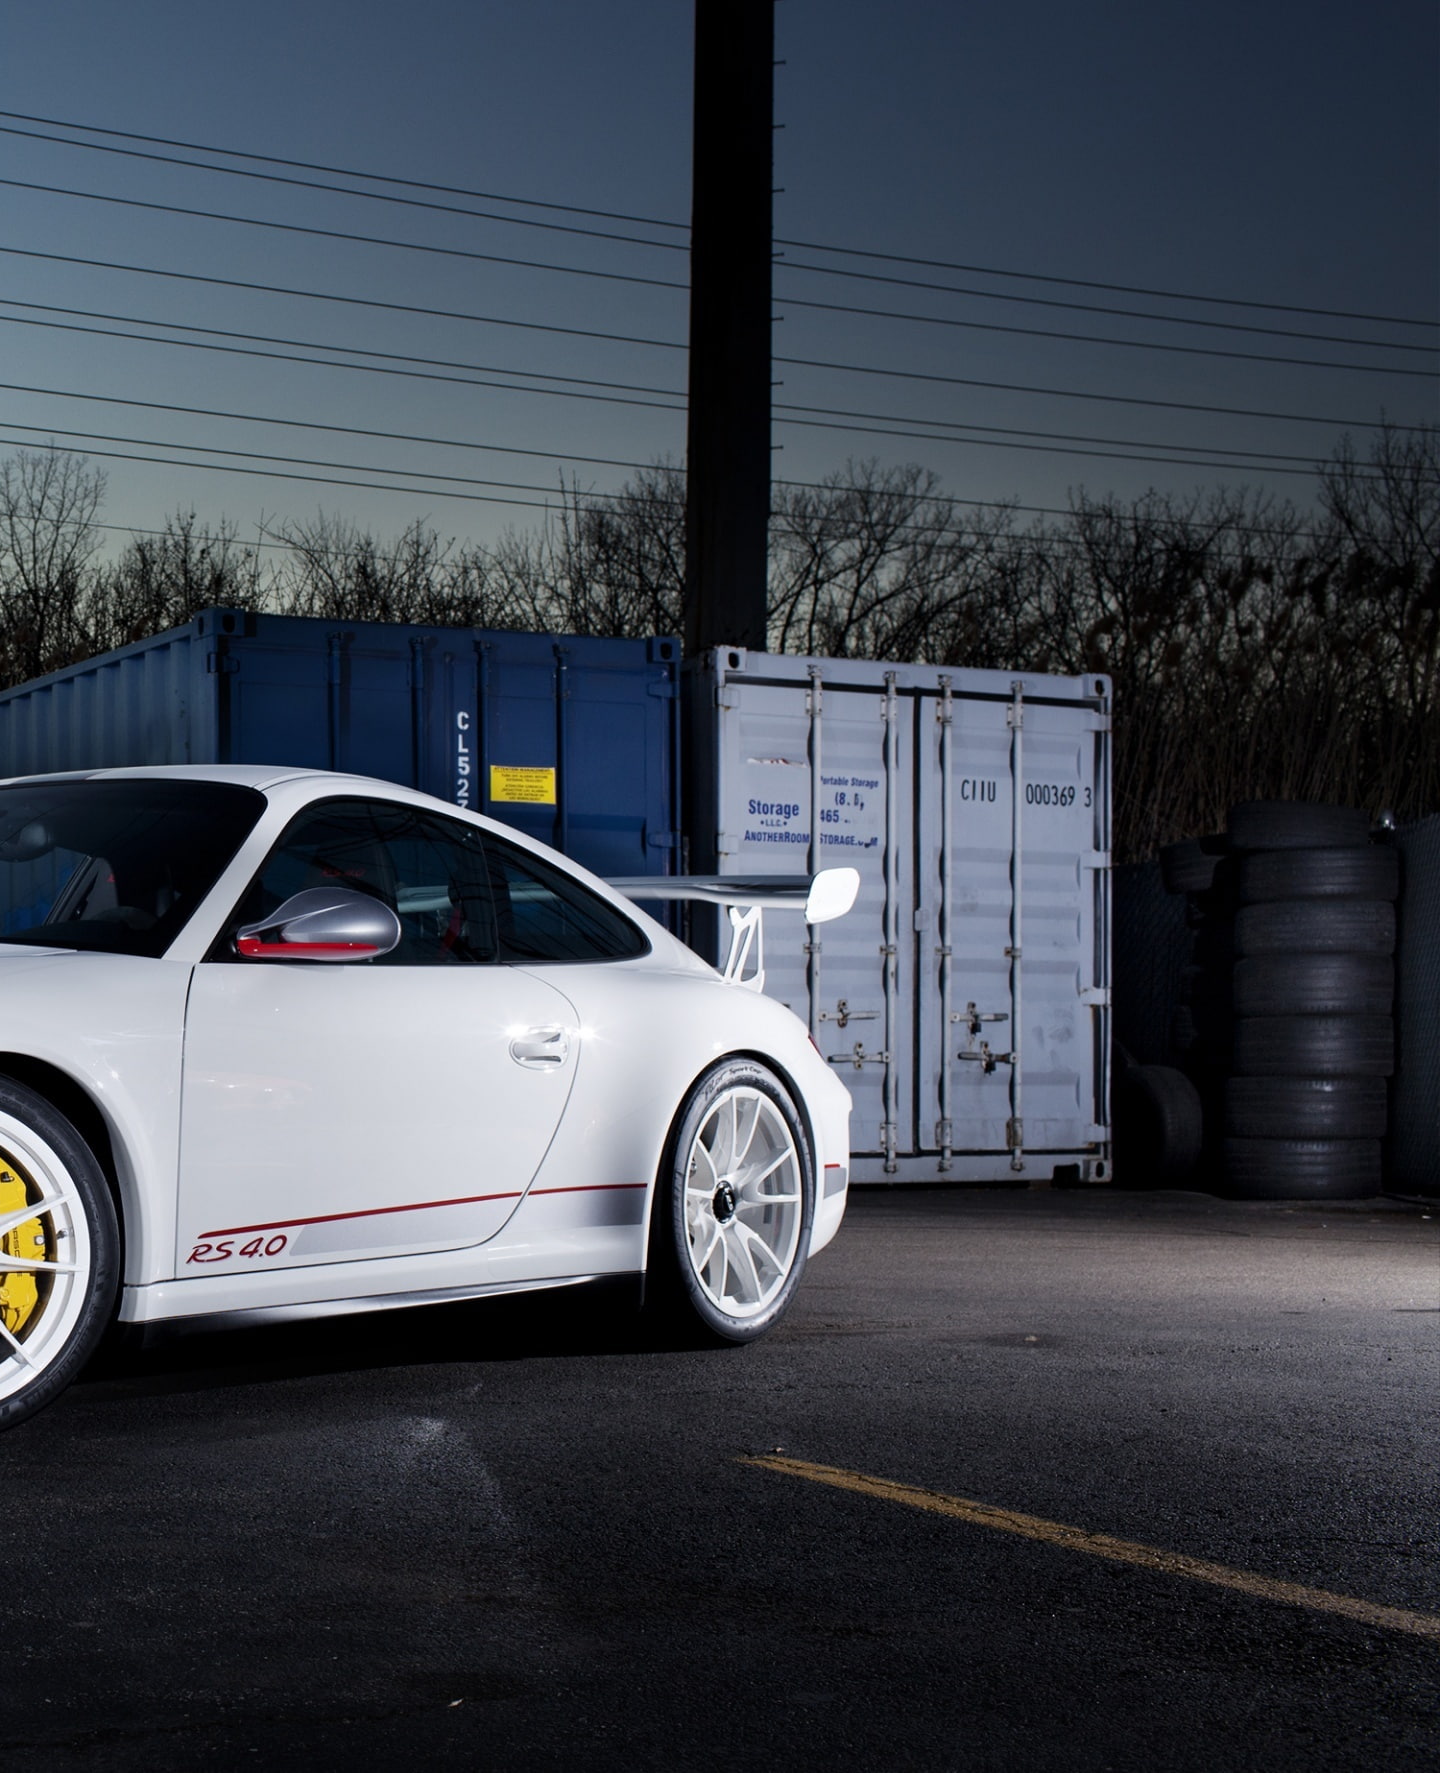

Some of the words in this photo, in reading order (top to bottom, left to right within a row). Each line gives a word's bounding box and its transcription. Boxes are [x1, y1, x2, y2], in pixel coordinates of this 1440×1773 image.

[851, 777, 879, 789] Storage
[1025, 783, 1075, 807] 000369
[1084, 786, 1092, 807] 3
[748, 799, 799, 819] Storage
[186, 1241, 234, 1264] RS
[239, 1234, 287, 1258] 4.0
